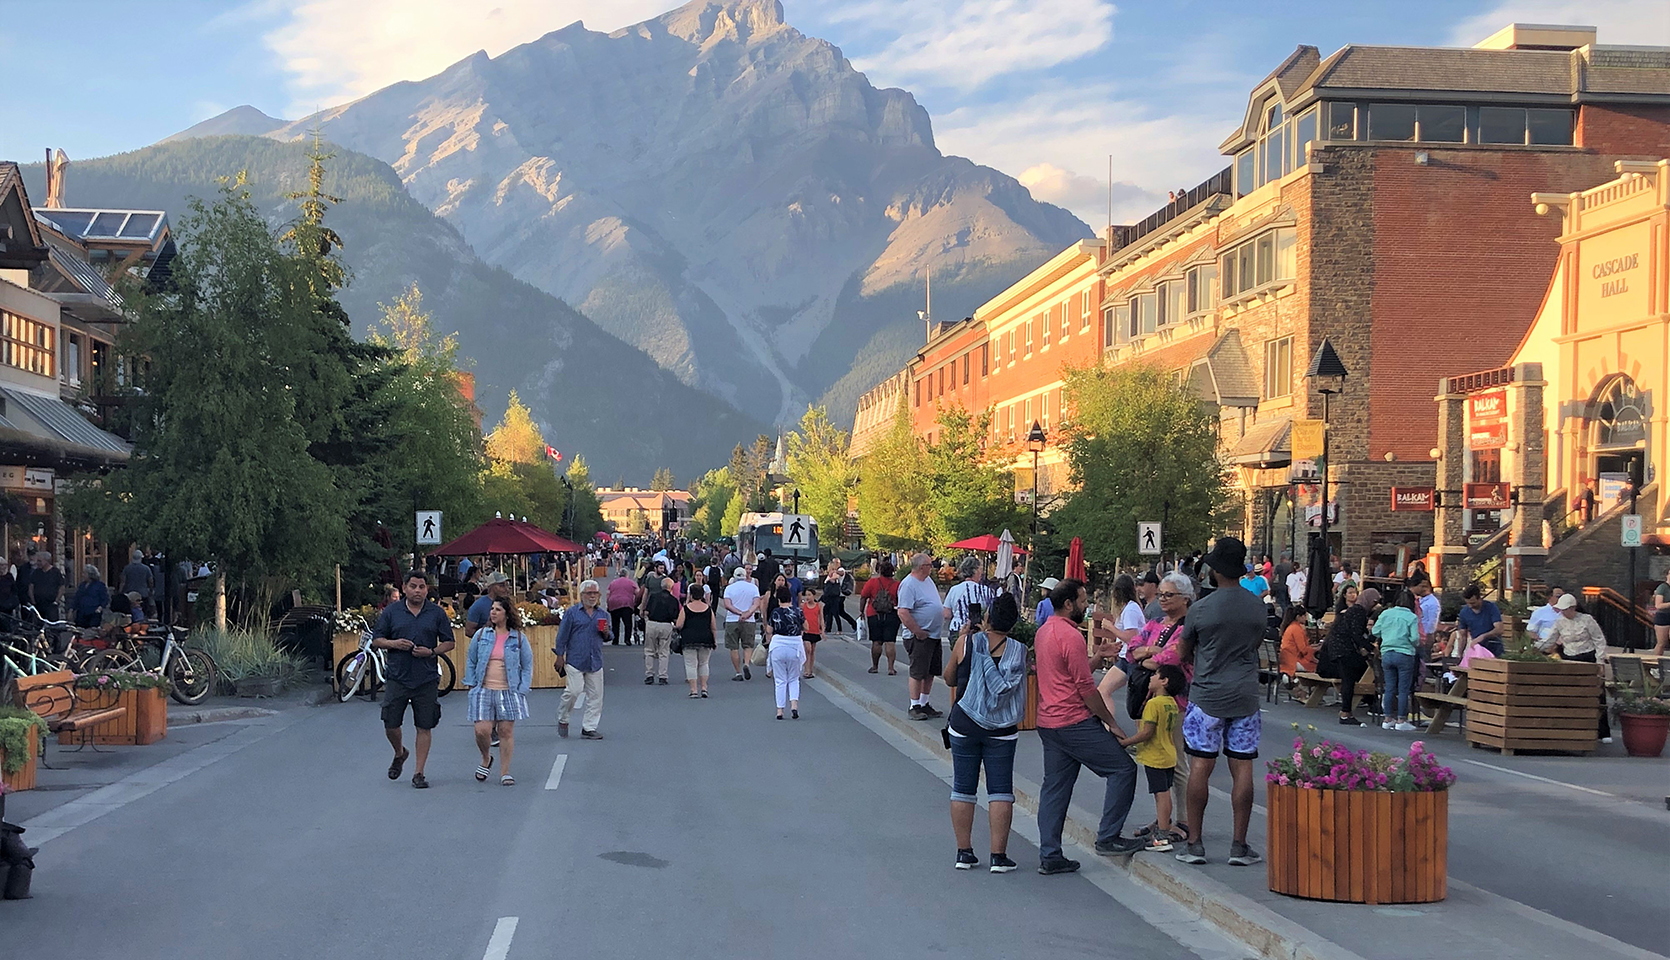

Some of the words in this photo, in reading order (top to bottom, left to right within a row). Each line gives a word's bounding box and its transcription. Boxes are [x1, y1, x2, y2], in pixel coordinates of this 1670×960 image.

[1592, 252, 1639, 280] CASCADE
[1601, 277, 1629, 299] HALL
[1474, 396, 1500, 412] BALKAN
[1296, 442, 1317, 451] Basin
[1396, 492, 1430, 502] BALKAN
